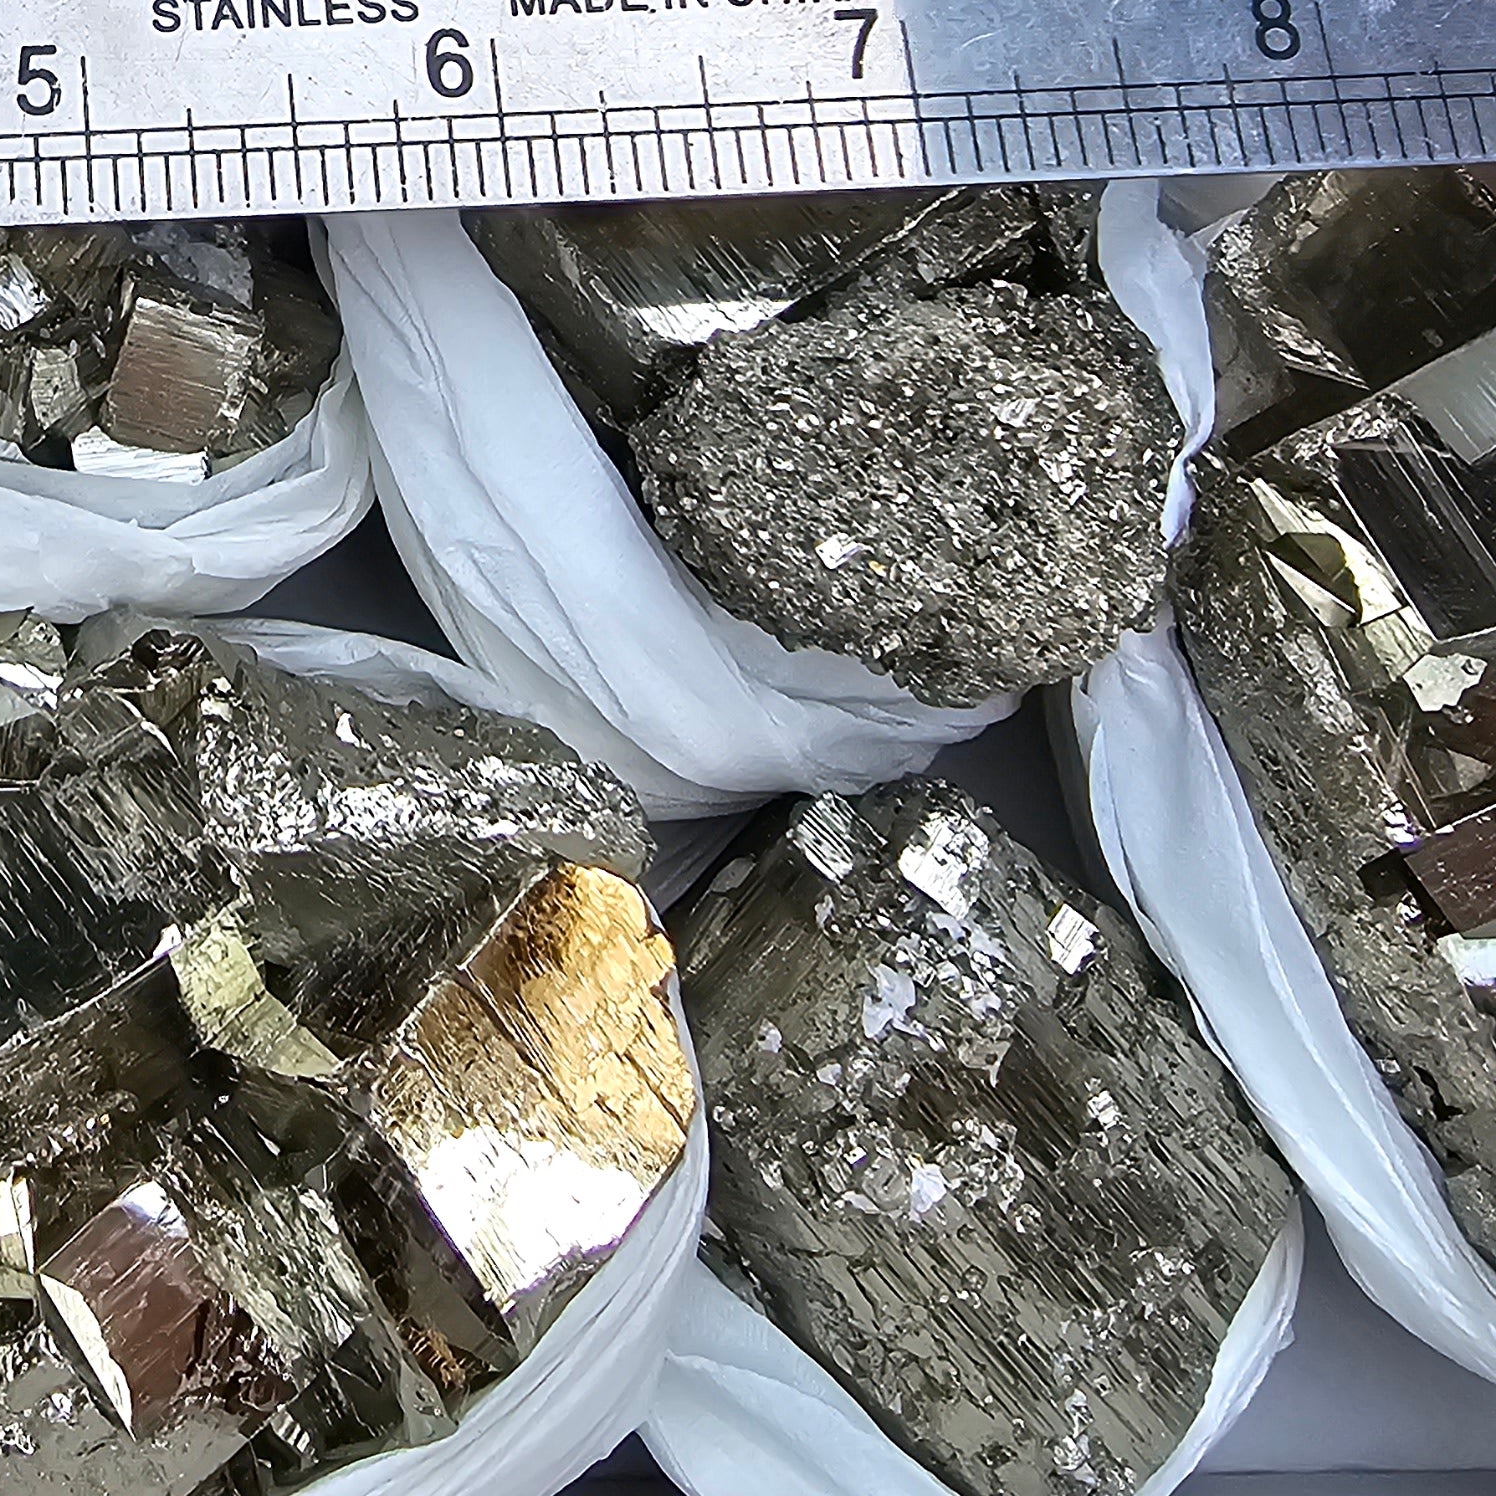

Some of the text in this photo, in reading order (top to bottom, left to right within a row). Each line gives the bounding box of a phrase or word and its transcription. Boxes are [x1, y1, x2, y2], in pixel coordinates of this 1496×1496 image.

[16, 45, 61, 115] 5
[425, 29, 474, 97] 6
[834, 9, 877, 78] 7
